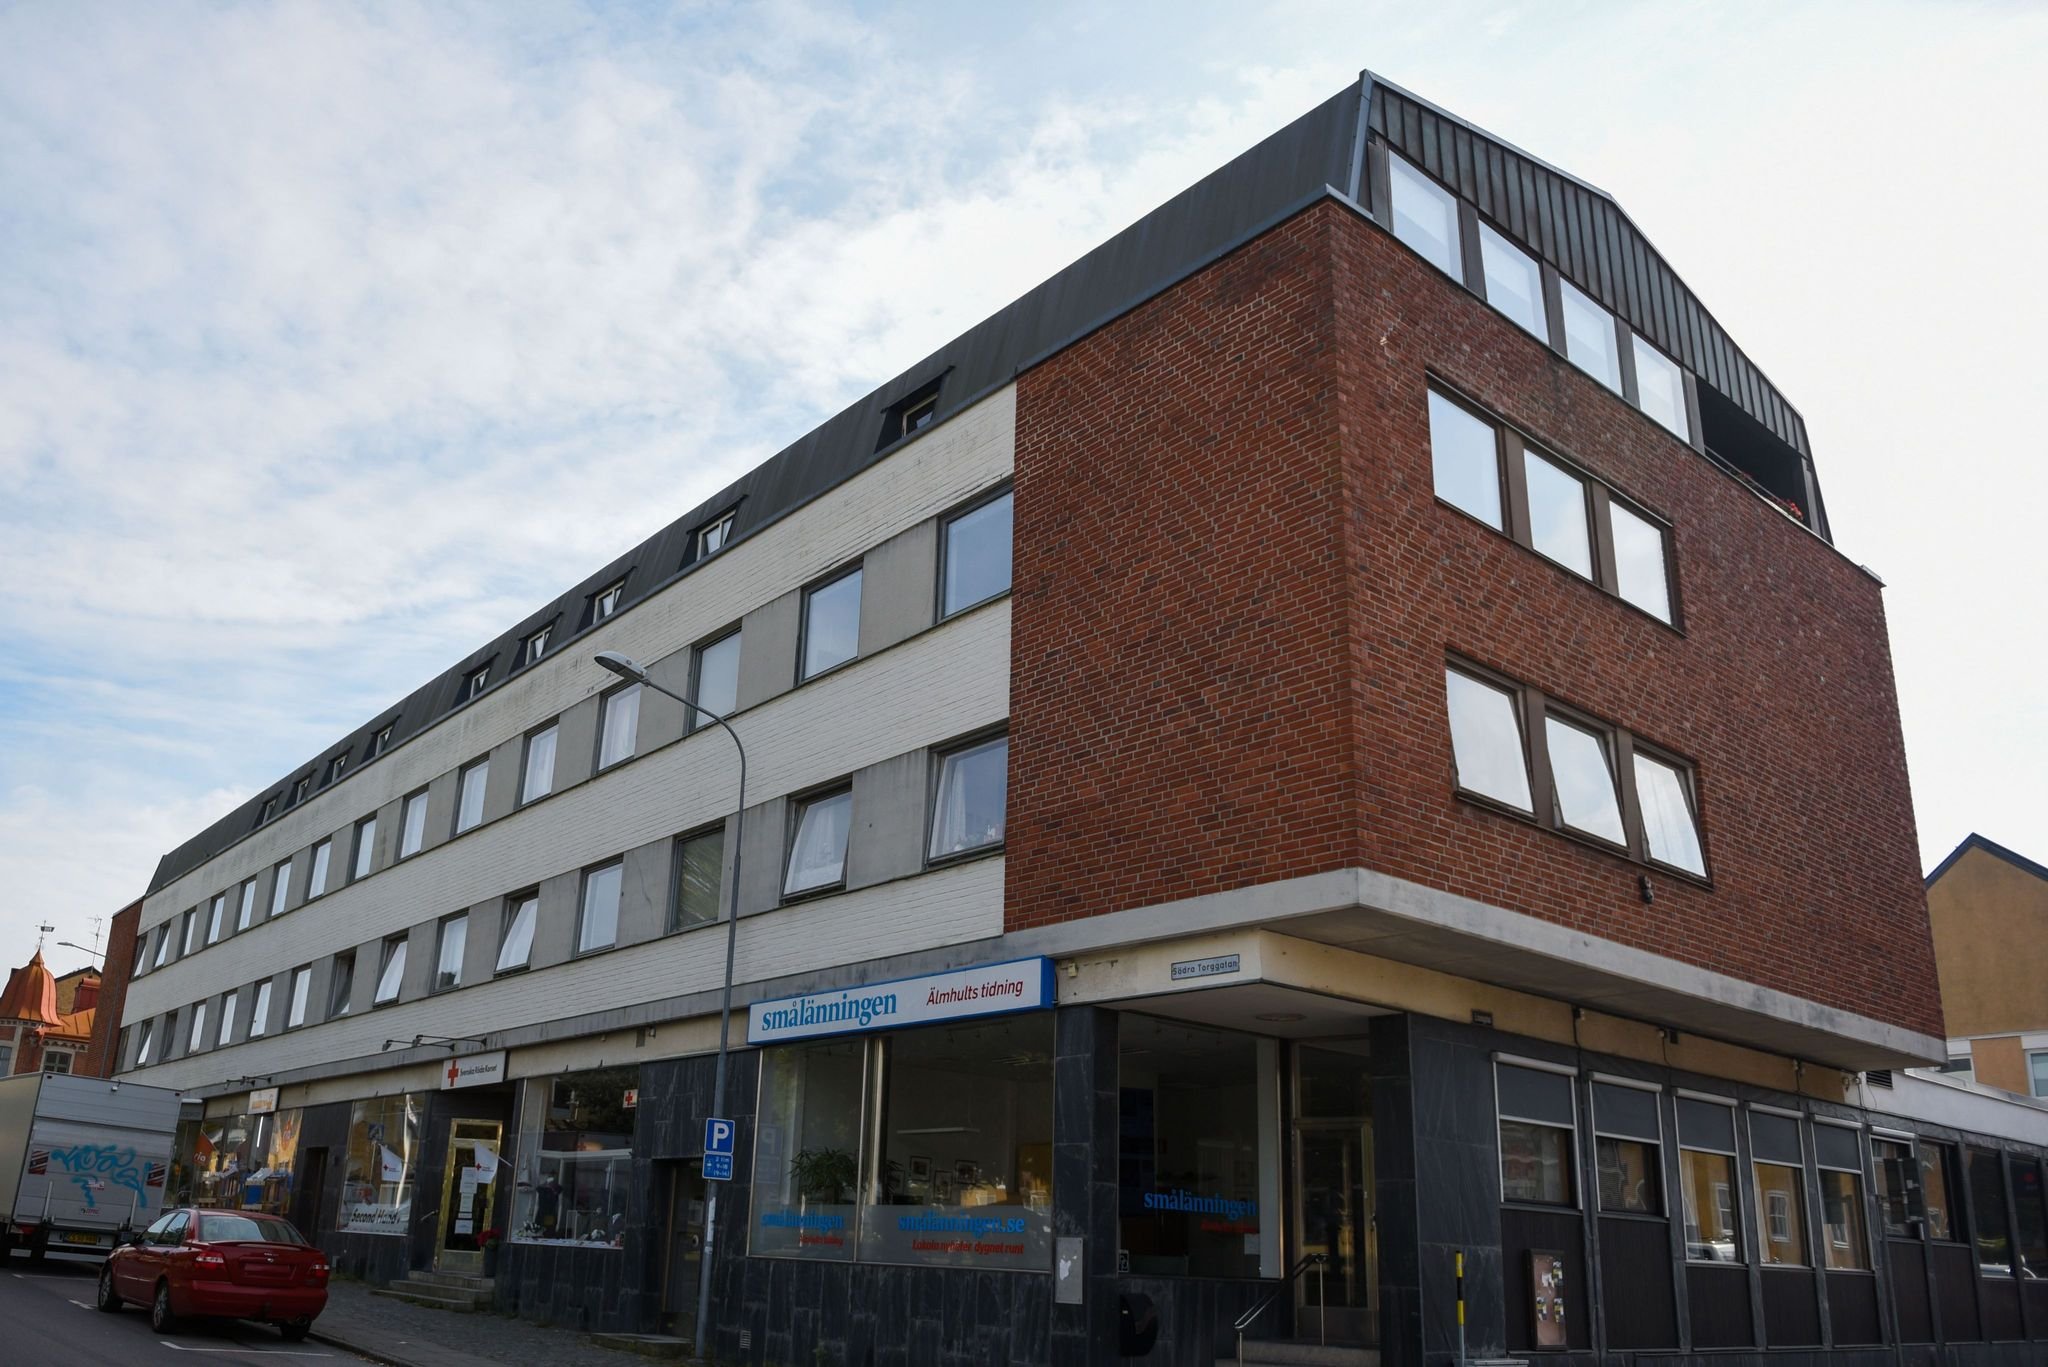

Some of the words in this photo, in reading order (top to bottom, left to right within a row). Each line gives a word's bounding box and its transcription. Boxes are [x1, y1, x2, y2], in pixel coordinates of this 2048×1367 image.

[1172, 966, 1195, 975] Södra
[1198, 961, 1237, 972] Torggatan
[926, 986, 978, 1006] Älmhults
[981, 979, 1024, 999] tidning
[761, 992, 897, 1031] smålänningen
[712, 1122, 729, 1149] P
[351, 1207, 378, 1224] Second
[1143, 1189, 1257, 1220] smålänningen
